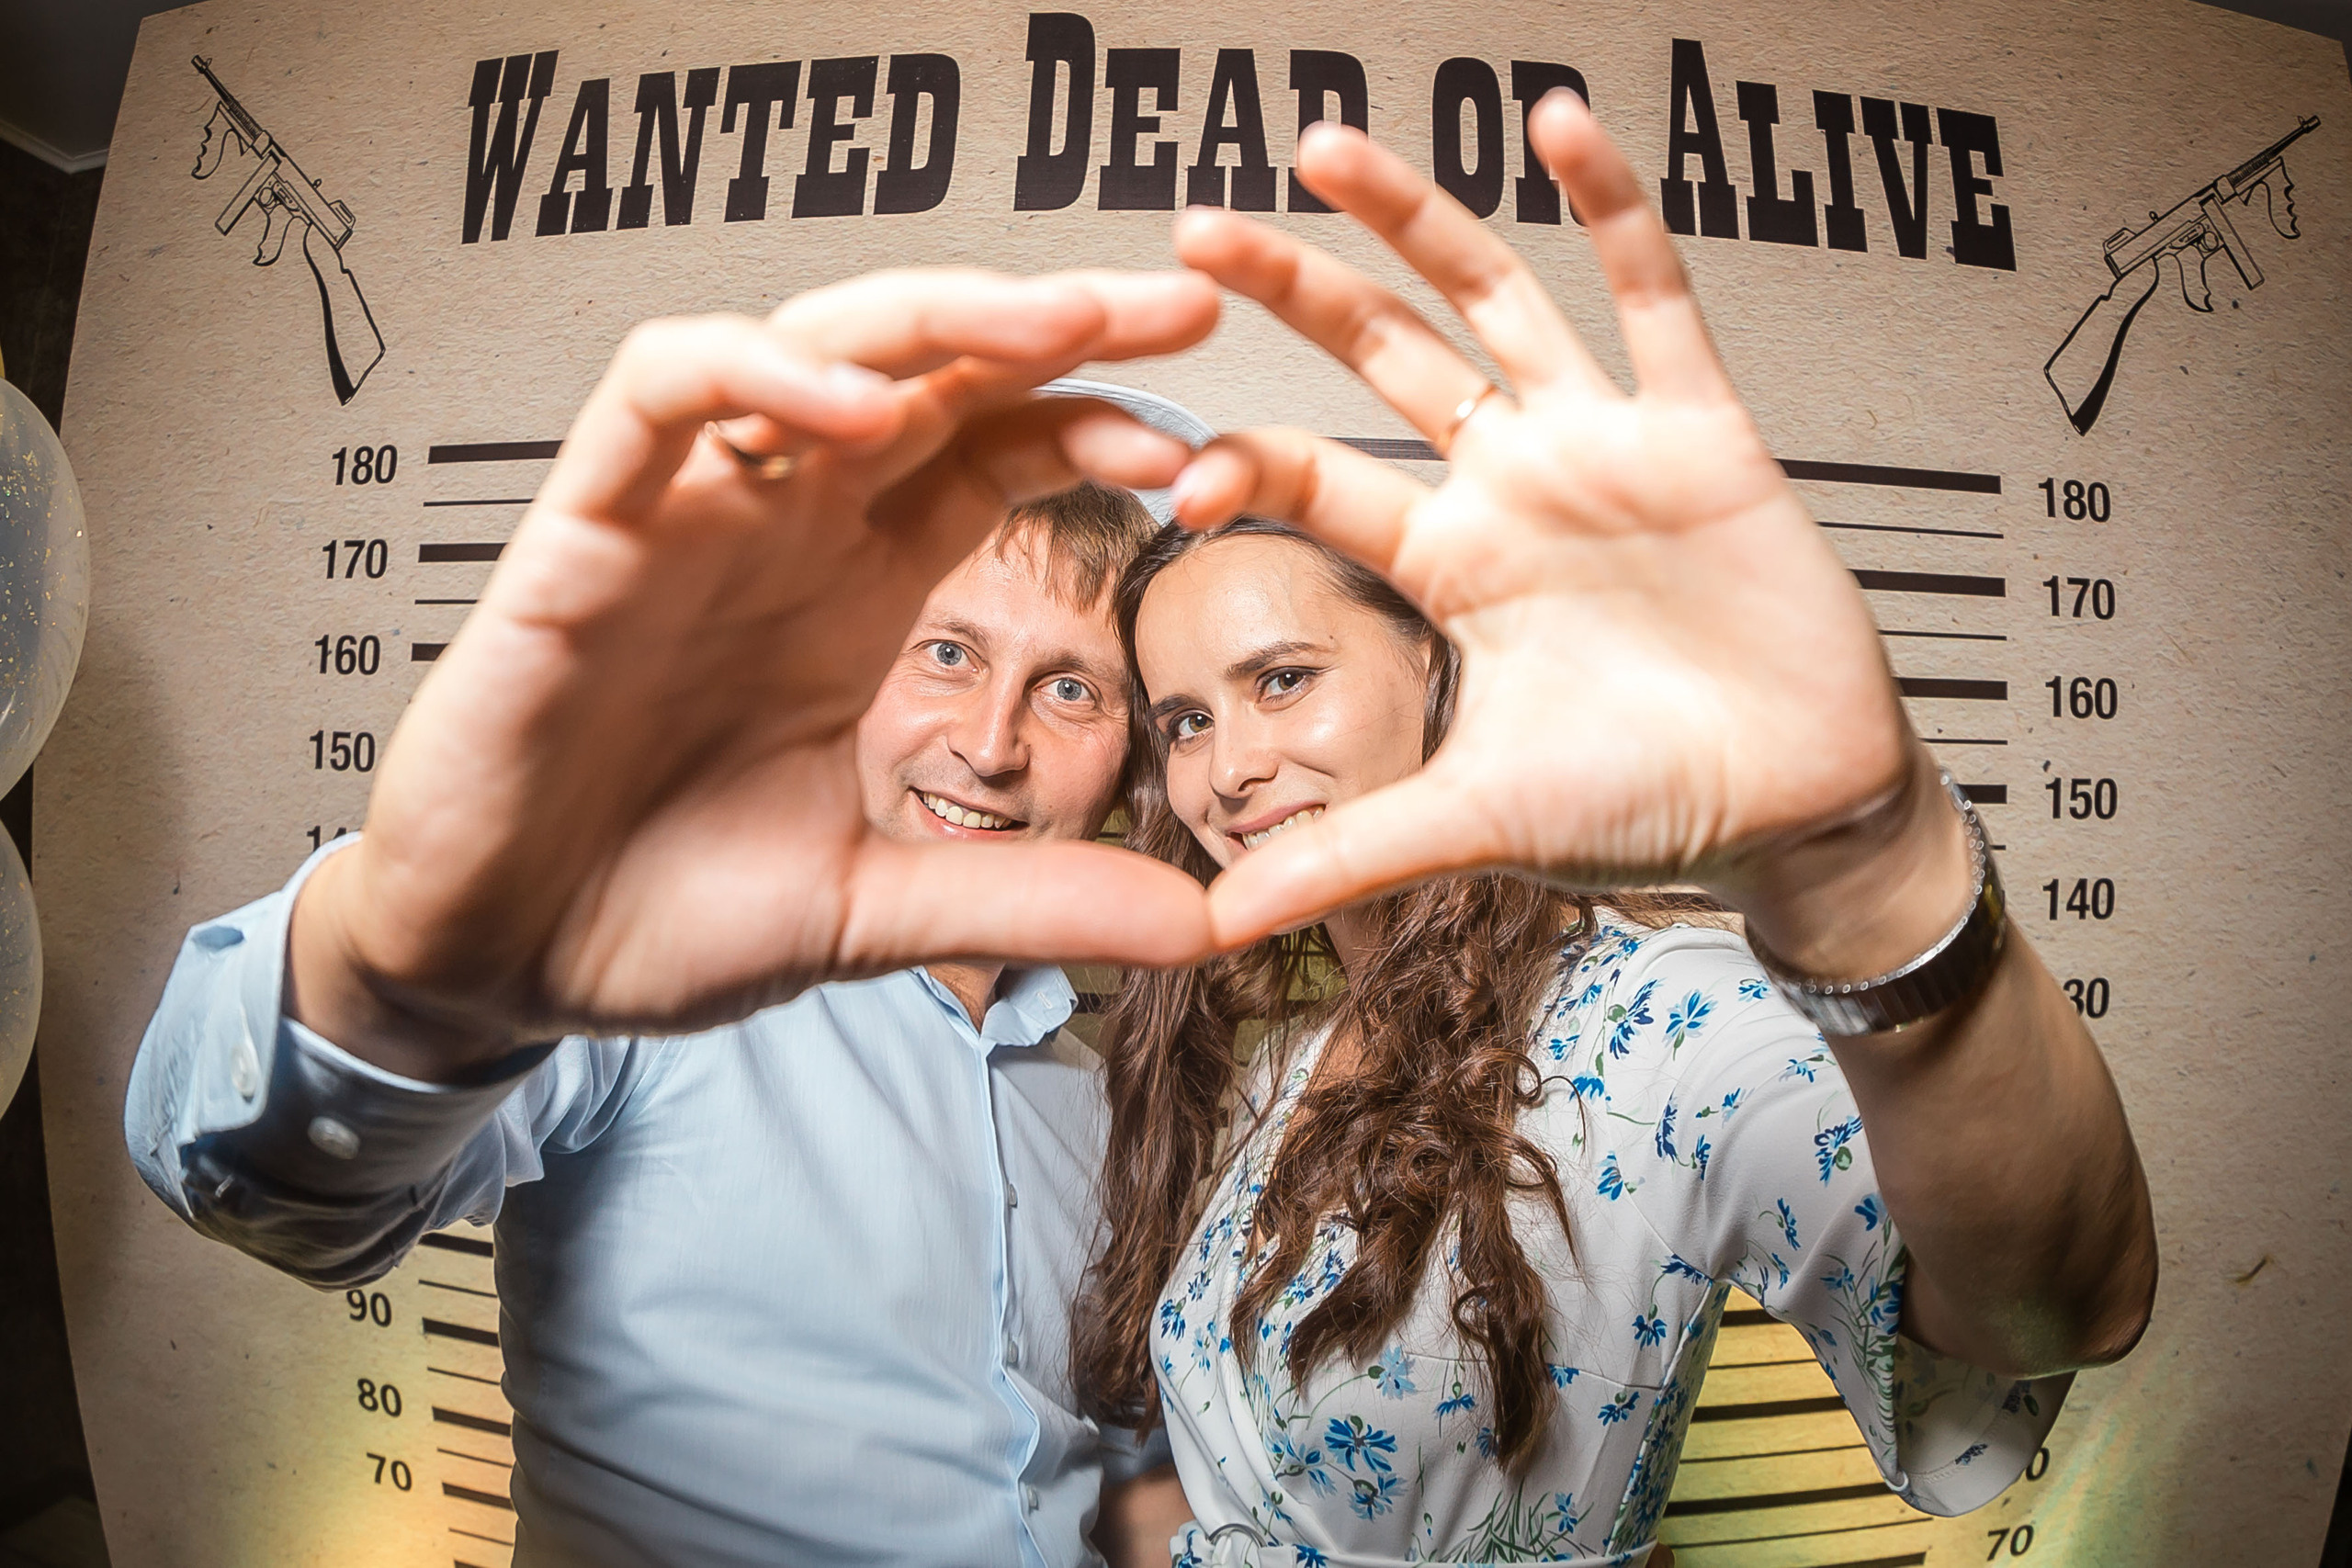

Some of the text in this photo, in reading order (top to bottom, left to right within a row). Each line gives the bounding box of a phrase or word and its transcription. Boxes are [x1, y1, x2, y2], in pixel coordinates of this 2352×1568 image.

[461, 50, 960, 244] WANTED
[1013, 12, 1369, 213] DEAD
[1660, 38, 2017, 272] ALIVE
[332, 444, 398, 486] 180
[2038, 477, 2111, 523] 180
[322, 538, 389, 580] 170
[2042, 575, 2116, 620] 170
[314, 634, 380, 675] 160
[2045, 675, 2118, 719] 160
[309, 729, 376, 773] 150
[2045, 777, 2118, 819] 150
[2042, 877, 2115, 920] 140
[2063, 977, 2110, 1019] 30
[346, 1289, 392, 1328] 90
[356, 1378, 402, 1418] 80
[367, 1452, 413, 1492] 70
[1986, 1524, 2034, 1562] 70
